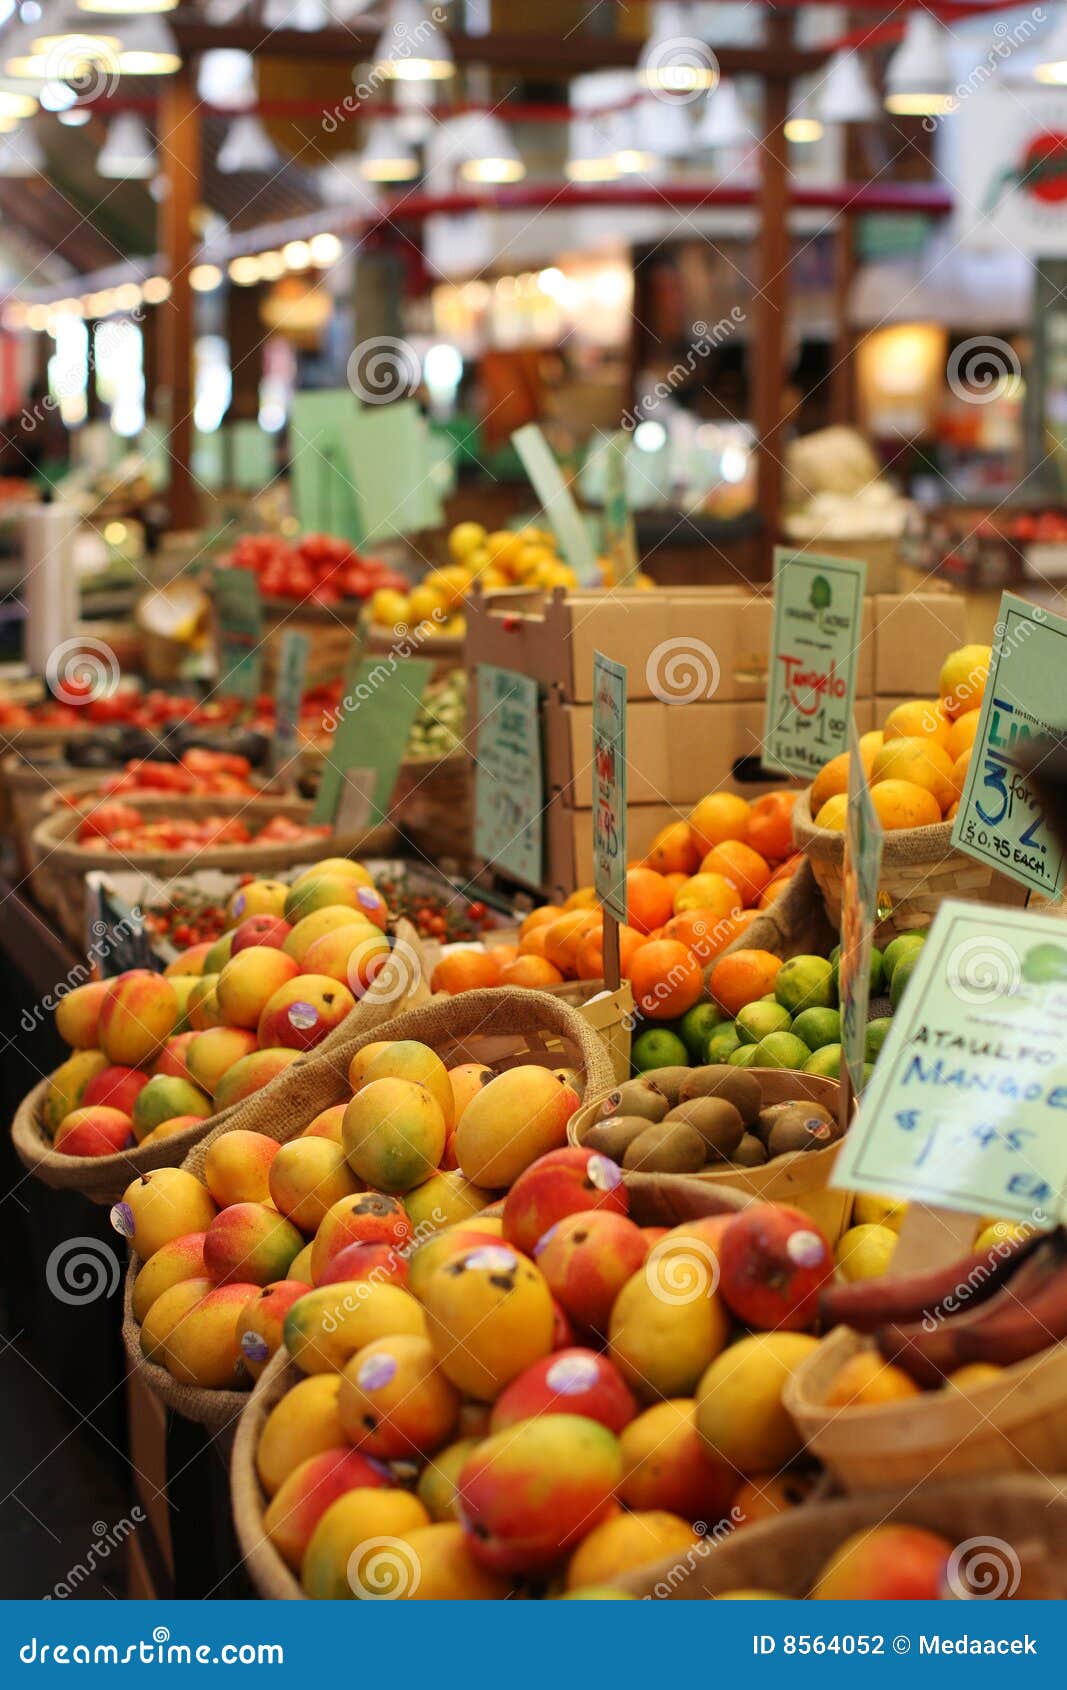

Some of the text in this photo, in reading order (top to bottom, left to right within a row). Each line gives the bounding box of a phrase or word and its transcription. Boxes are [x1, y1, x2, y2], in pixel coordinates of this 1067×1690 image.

[776, 692, 792, 734] 2
[975, 760, 1008, 826] 3
[1008, 773, 1032, 819] for
[964, 820, 1011, 859] $0.75
[911, 1025, 1056, 1066] ATAULFO
